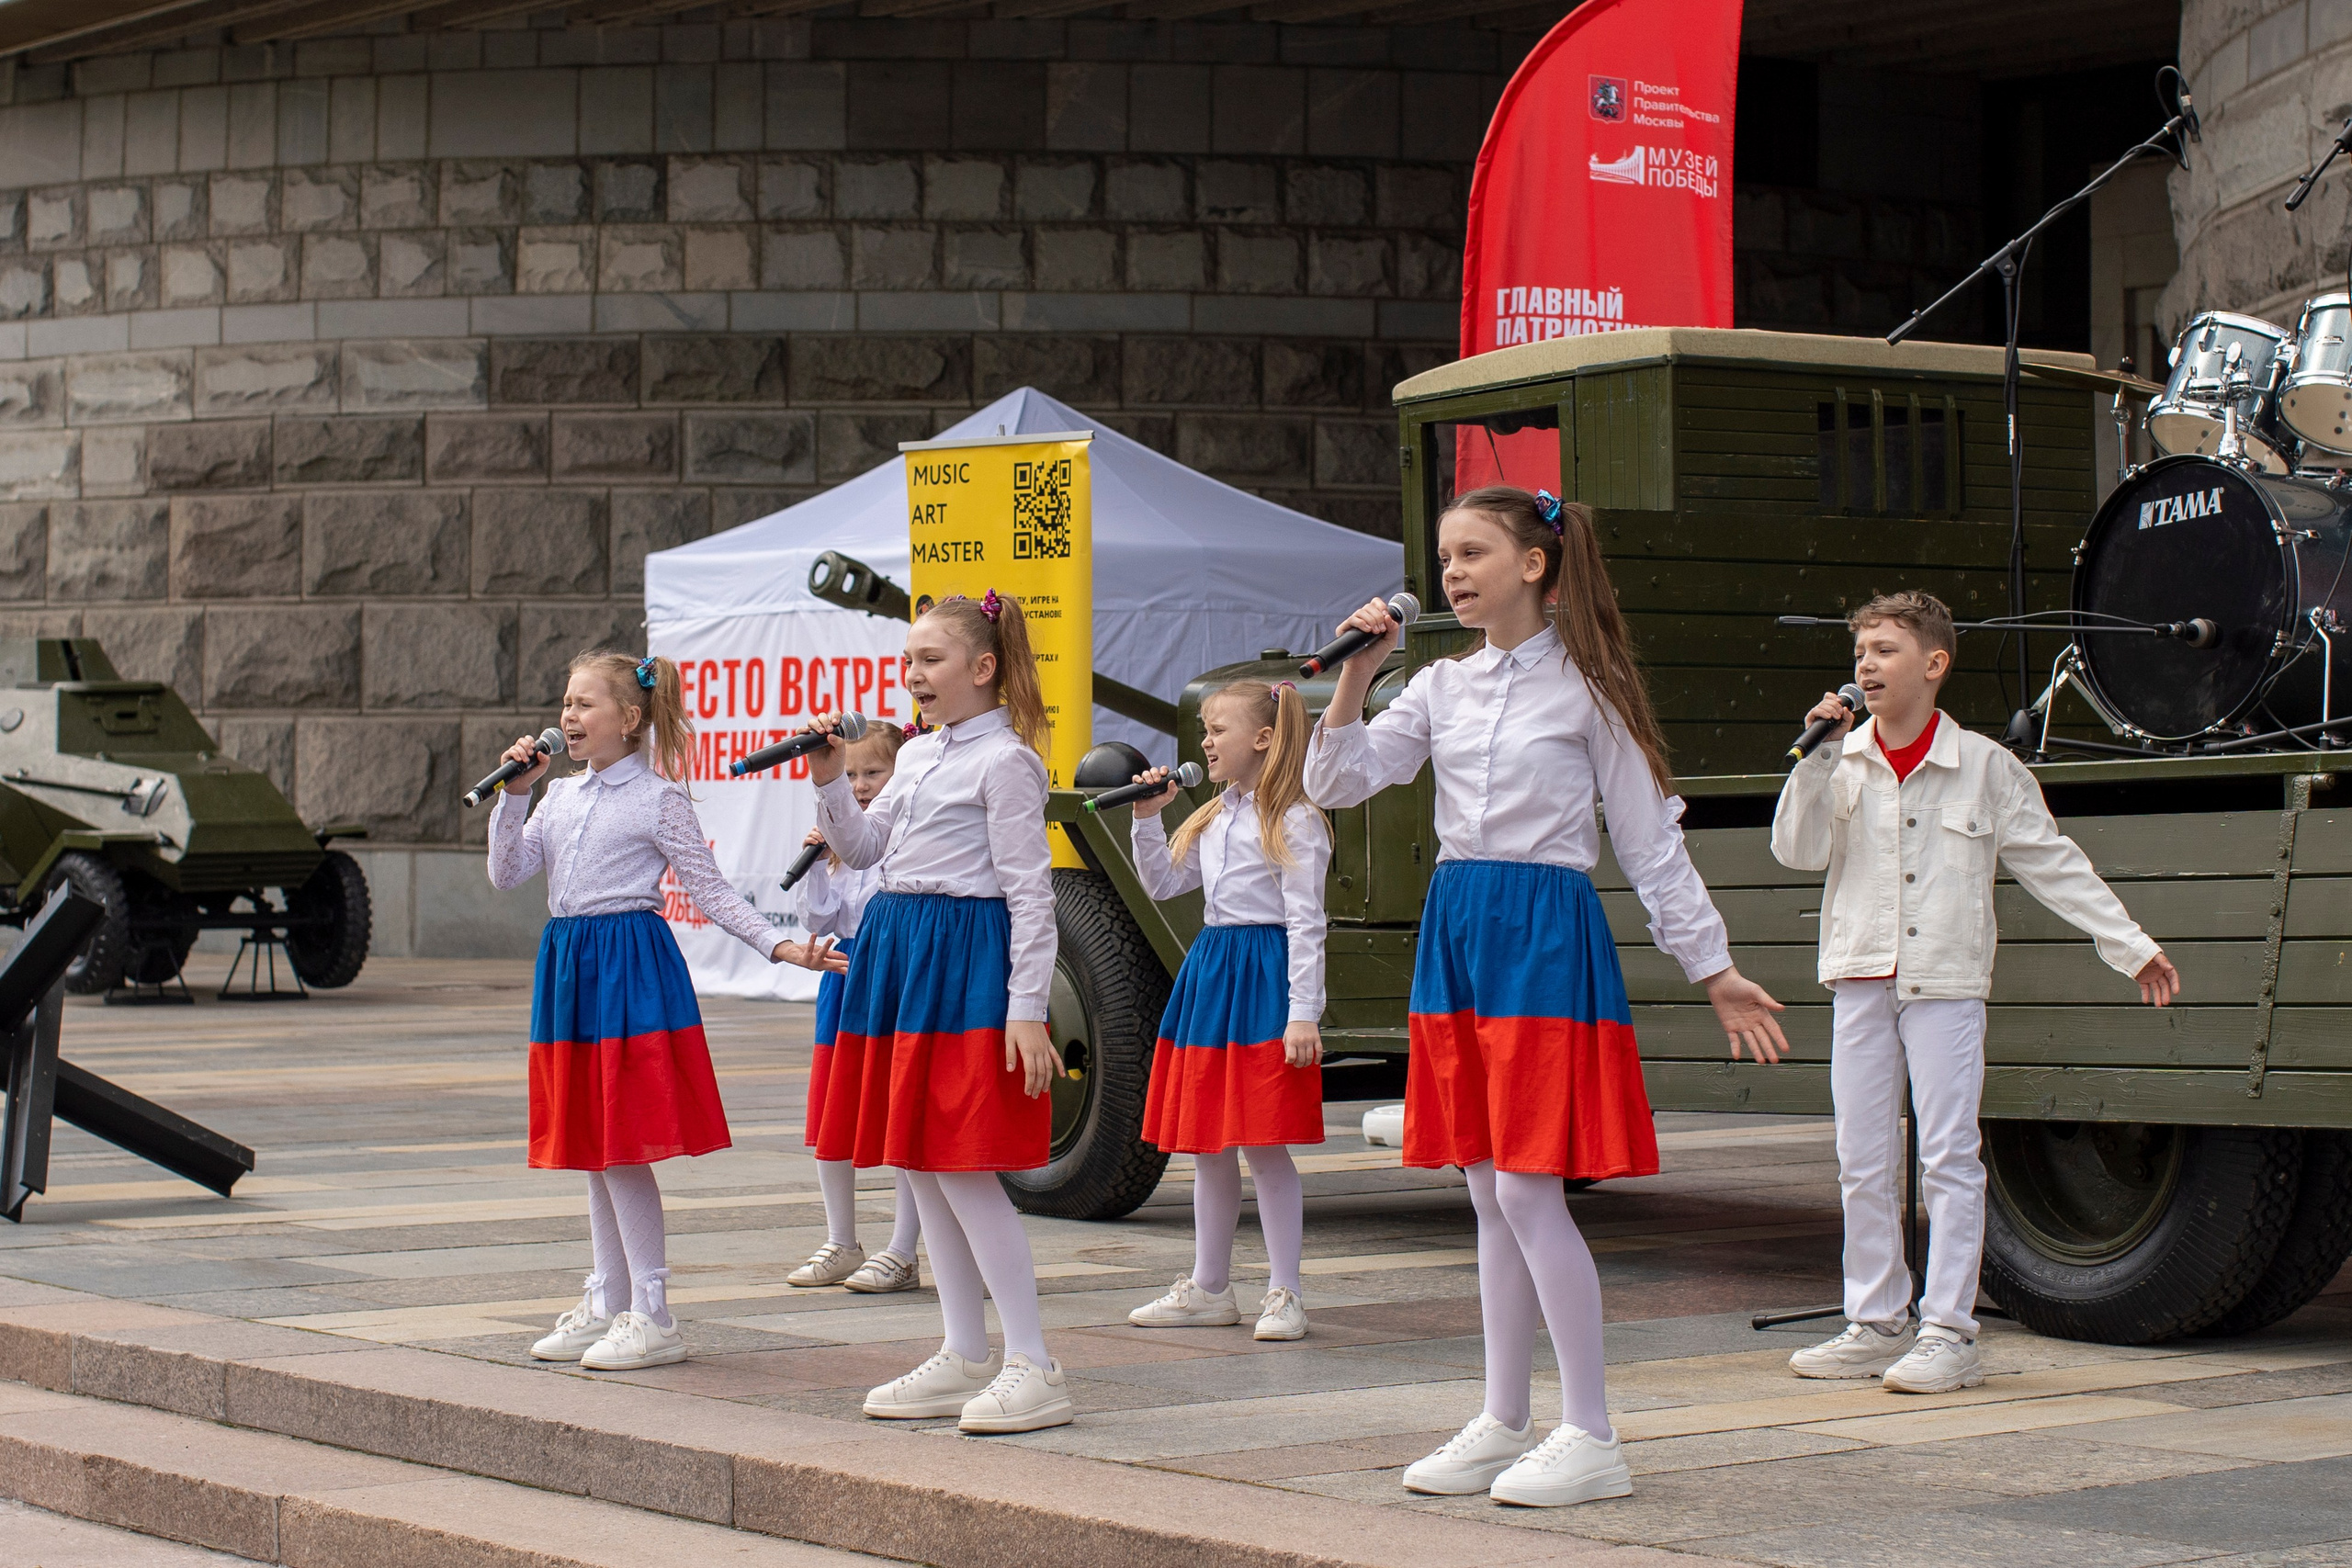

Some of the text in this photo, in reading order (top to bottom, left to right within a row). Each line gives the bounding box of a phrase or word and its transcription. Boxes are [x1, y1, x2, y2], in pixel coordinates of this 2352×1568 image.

[1634, 81, 1679, 96] Проект
[1634, 96, 1720, 123] Правительства
[1634, 113, 1684, 129] Москвы
[1648, 147, 1718, 178] МУЗЕЙ
[1648, 168, 1718, 198] ПОБЕДЫ
[1497, 286, 1623, 320] ГЛАВНЫЙ
[913, 463, 970, 486] MUSIC
[911, 503, 947, 525] ART
[2154, 488, 2222, 526] TAMA
[912, 541, 985, 564] MASTER
[1030, 595, 1050, 605] ИГРЕ
[675, 657, 764, 719] ЕСТО
